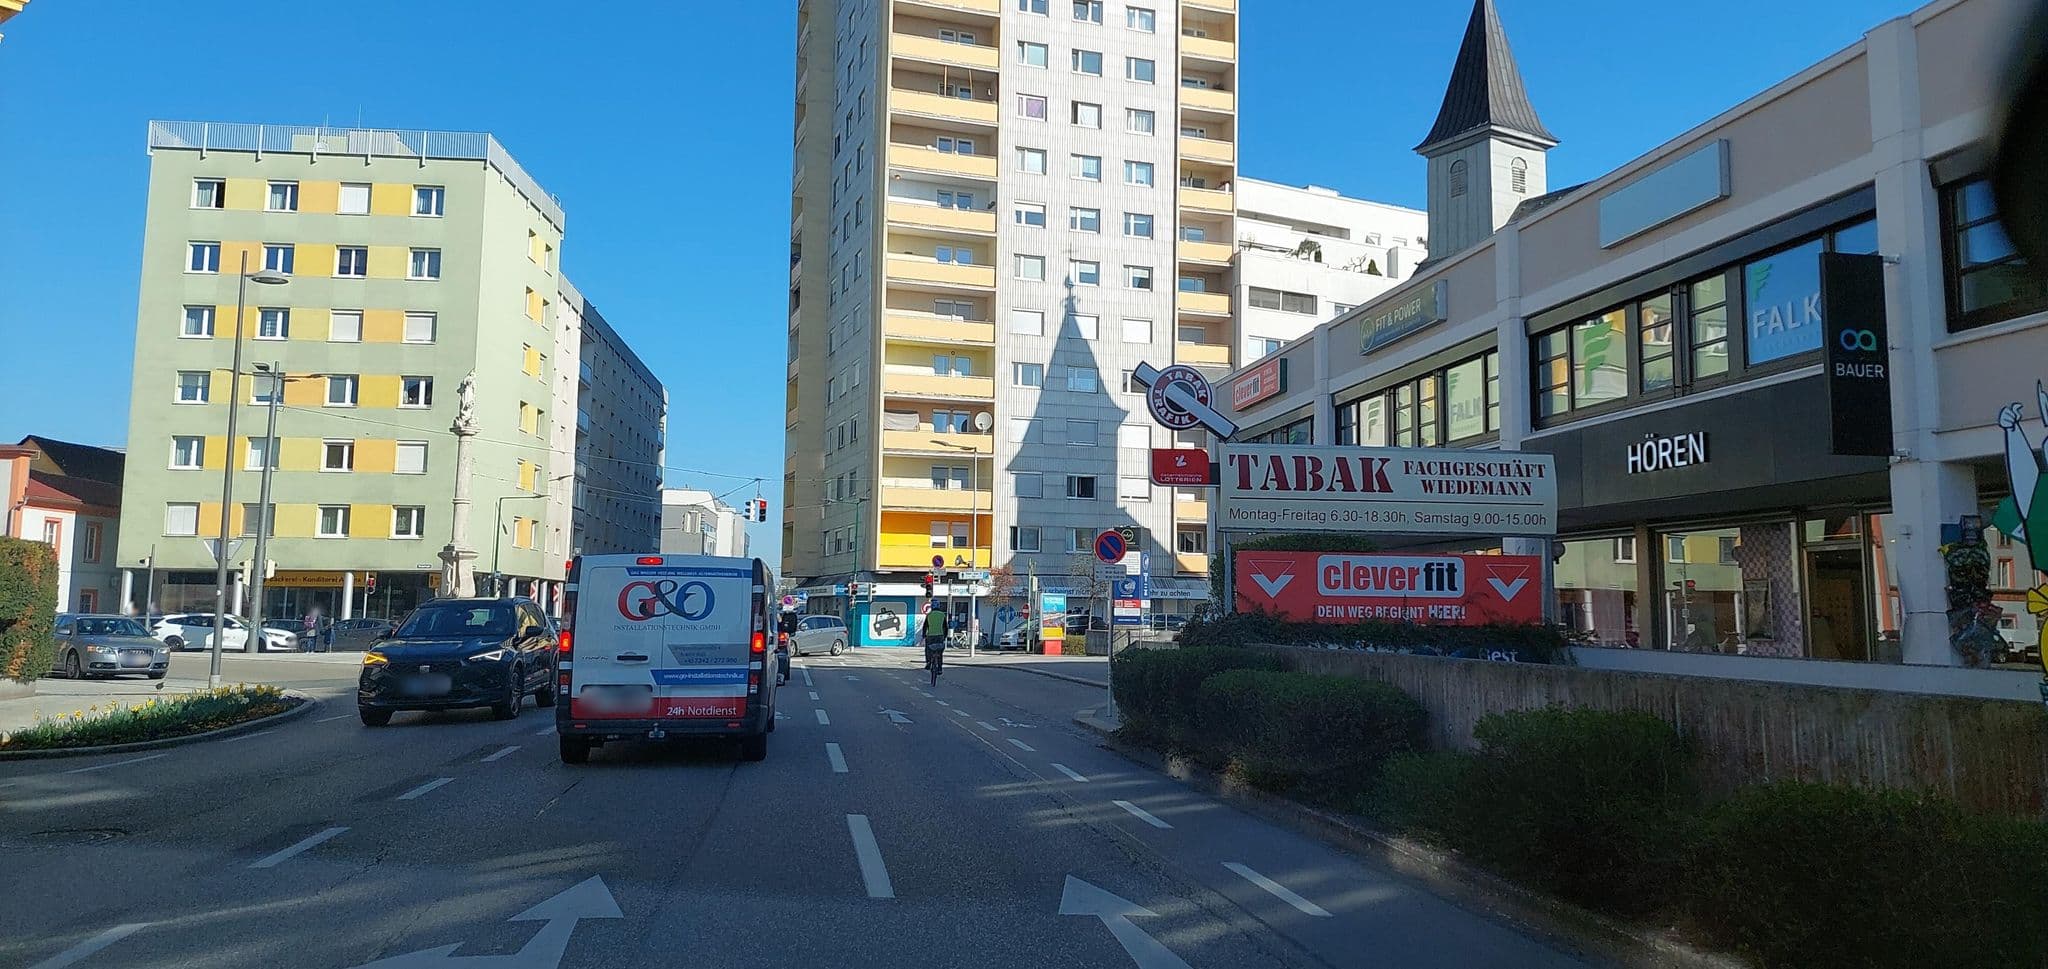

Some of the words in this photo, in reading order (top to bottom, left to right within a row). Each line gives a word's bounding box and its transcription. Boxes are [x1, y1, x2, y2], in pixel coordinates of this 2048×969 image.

[1375, 314, 1387, 332] FIT
[1387, 313, 1393, 327] &
[1394, 298, 1421, 323] POWER
[1835, 362, 1885, 378] BAUER
[1166, 371, 1207, 398] TABAK
[1154, 388, 1191, 425] TRAFIK
[1627, 431, 1705, 474] HÖREN
[1229, 454, 1394, 493] TABAK
[1403, 459, 1546, 479] FACHGESCHÄFT
[1421, 479, 1533, 497] WIEDEMANN
[1229, 507, 1327, 523] Montag-Freitag
[1414, 511, 1469, 527] Samstag
[1473, 512, 1547, 527] 9.00-15.00h
[618, 580, 716, 621] G&O
[1317, 605, 1345, 618] DEIN
[1348, 605, 1373, 618] WEG
[1428, 605, 1466, 620] HIER!
[667, 706, 685, 716] 24h
[688, 706, 737, 716] Notdienst
